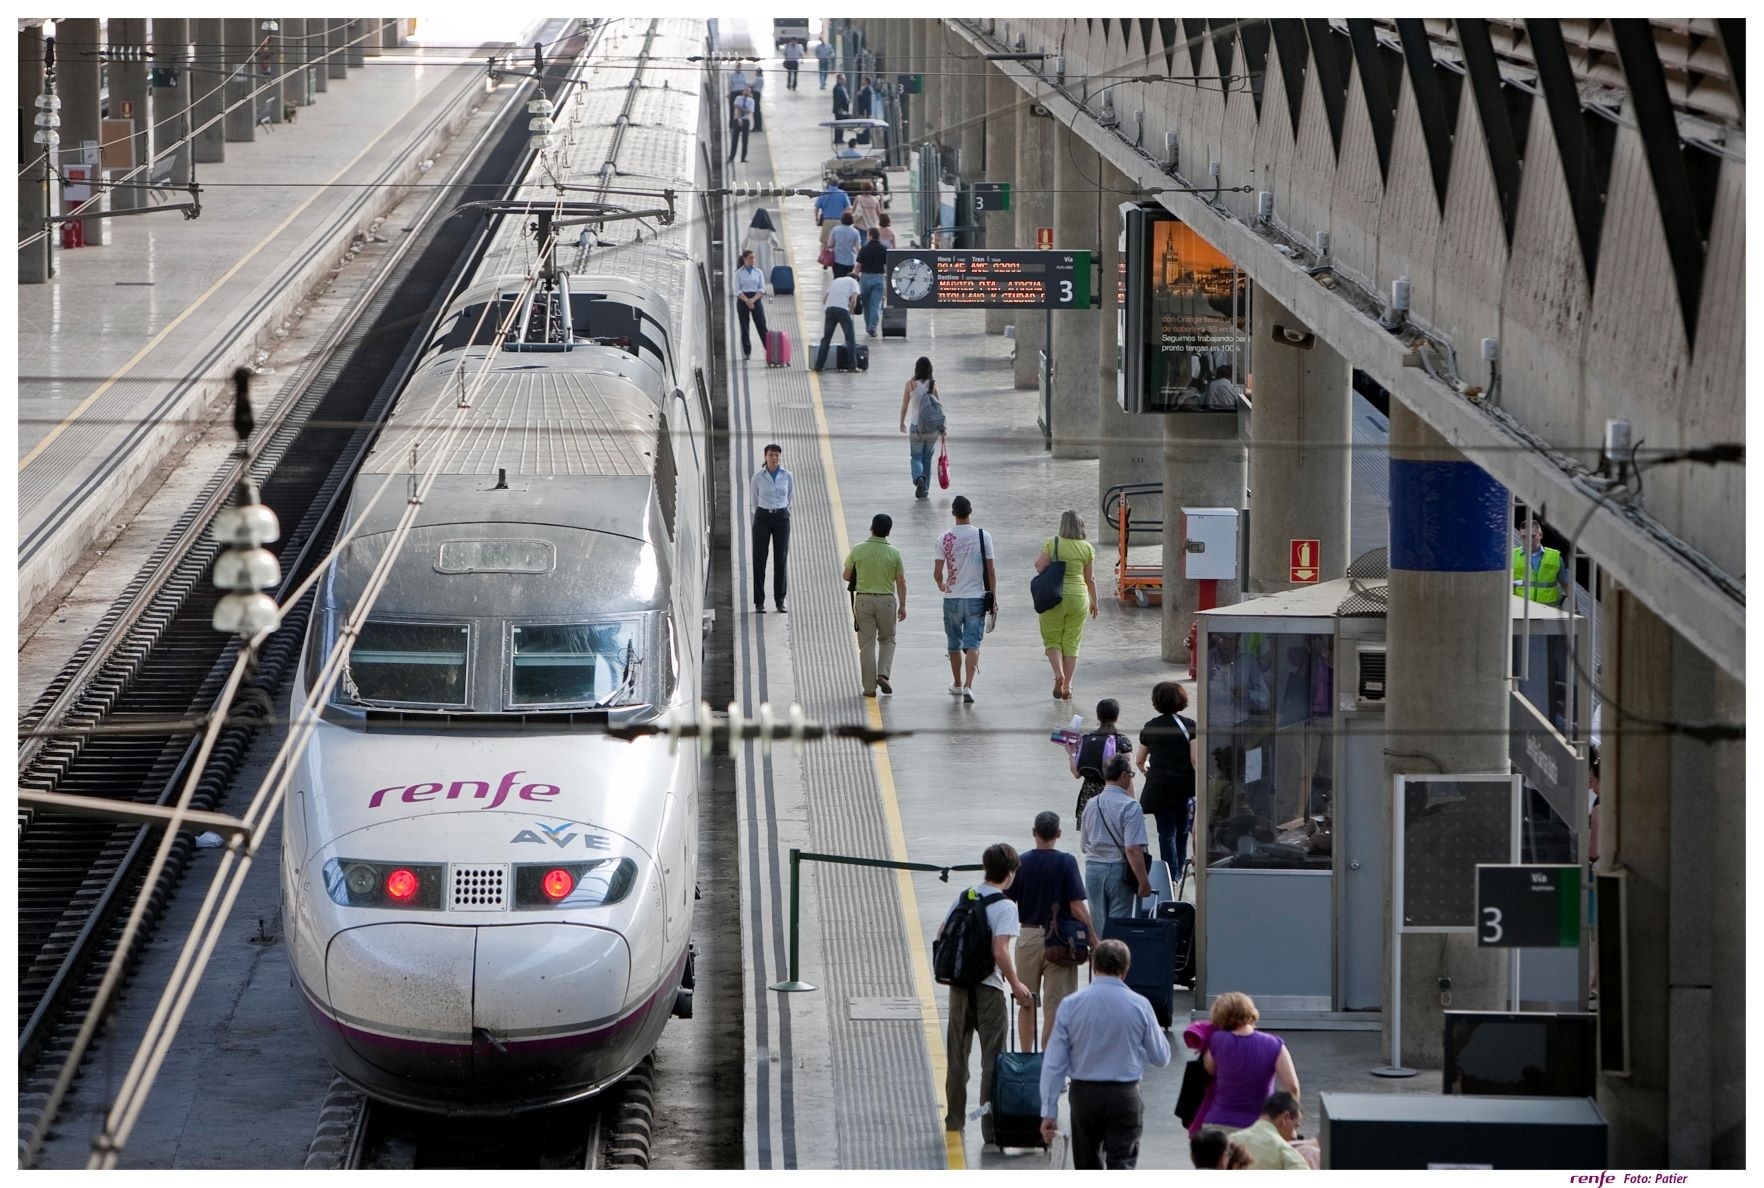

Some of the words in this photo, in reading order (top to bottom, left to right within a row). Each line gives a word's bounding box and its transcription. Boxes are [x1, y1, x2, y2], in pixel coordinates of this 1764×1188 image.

[898, 83, 905, 94] 3
[975, 196, 984, 210] 3
[939, 281, 975, 291] MADRID
[1059, 280, 1073, 302] 3
[1161, 334, 1196, 343] Seguimos
[1197, 334, 1234, 343] trabajando
[368, 770, 561, 810] renfe
[510, 822, 612, 850] AVE
[1482, 906, 1503, 943] 3
